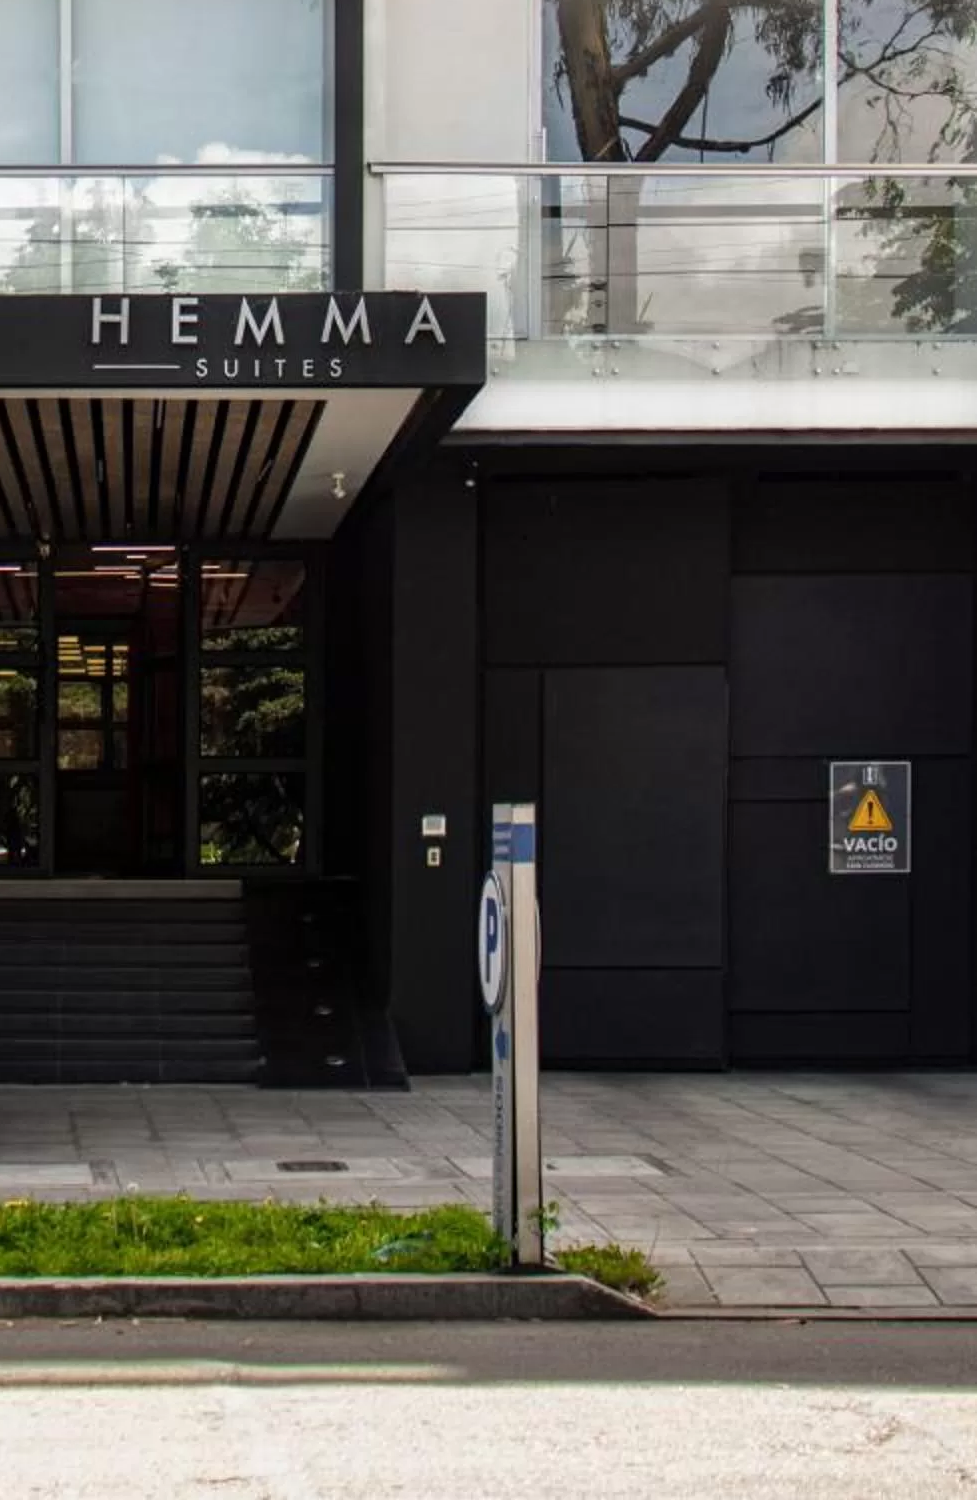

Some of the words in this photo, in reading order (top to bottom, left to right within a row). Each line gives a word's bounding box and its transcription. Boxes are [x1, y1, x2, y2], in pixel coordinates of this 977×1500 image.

[91, 296, 446, 345] HEMMA
[195, 358, 343, 378] SUITES
[843, 834, 898, 852] VACÍO
[486, 896, 498, 983] P
